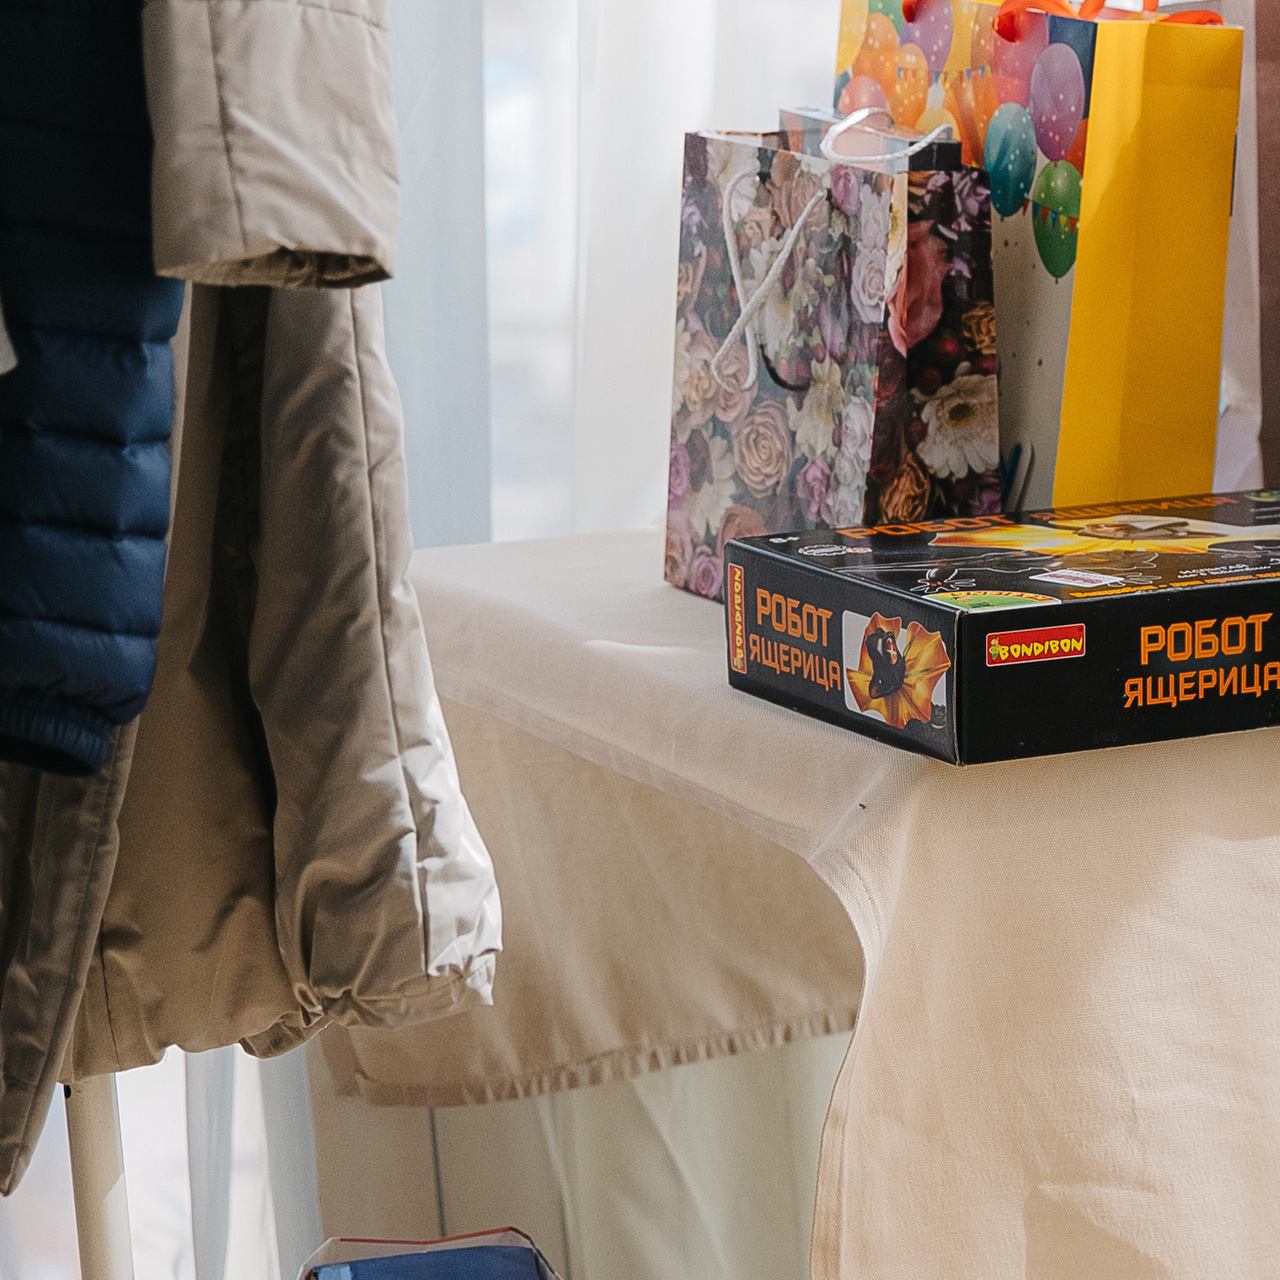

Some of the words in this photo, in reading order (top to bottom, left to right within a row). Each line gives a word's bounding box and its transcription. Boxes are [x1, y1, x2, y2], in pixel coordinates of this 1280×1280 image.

[837, 514, 1015, 539] РОБОТ
[733, 566, 745, 658] BONDIBON
[756, 587, 833, 647] РОБОТ
[1140, 613, 1273, 665] РОБОТ
[749, 633, 841, 692] ЯЩЕРИЦА
[999, 637, 1083, 661] BONDIBON
